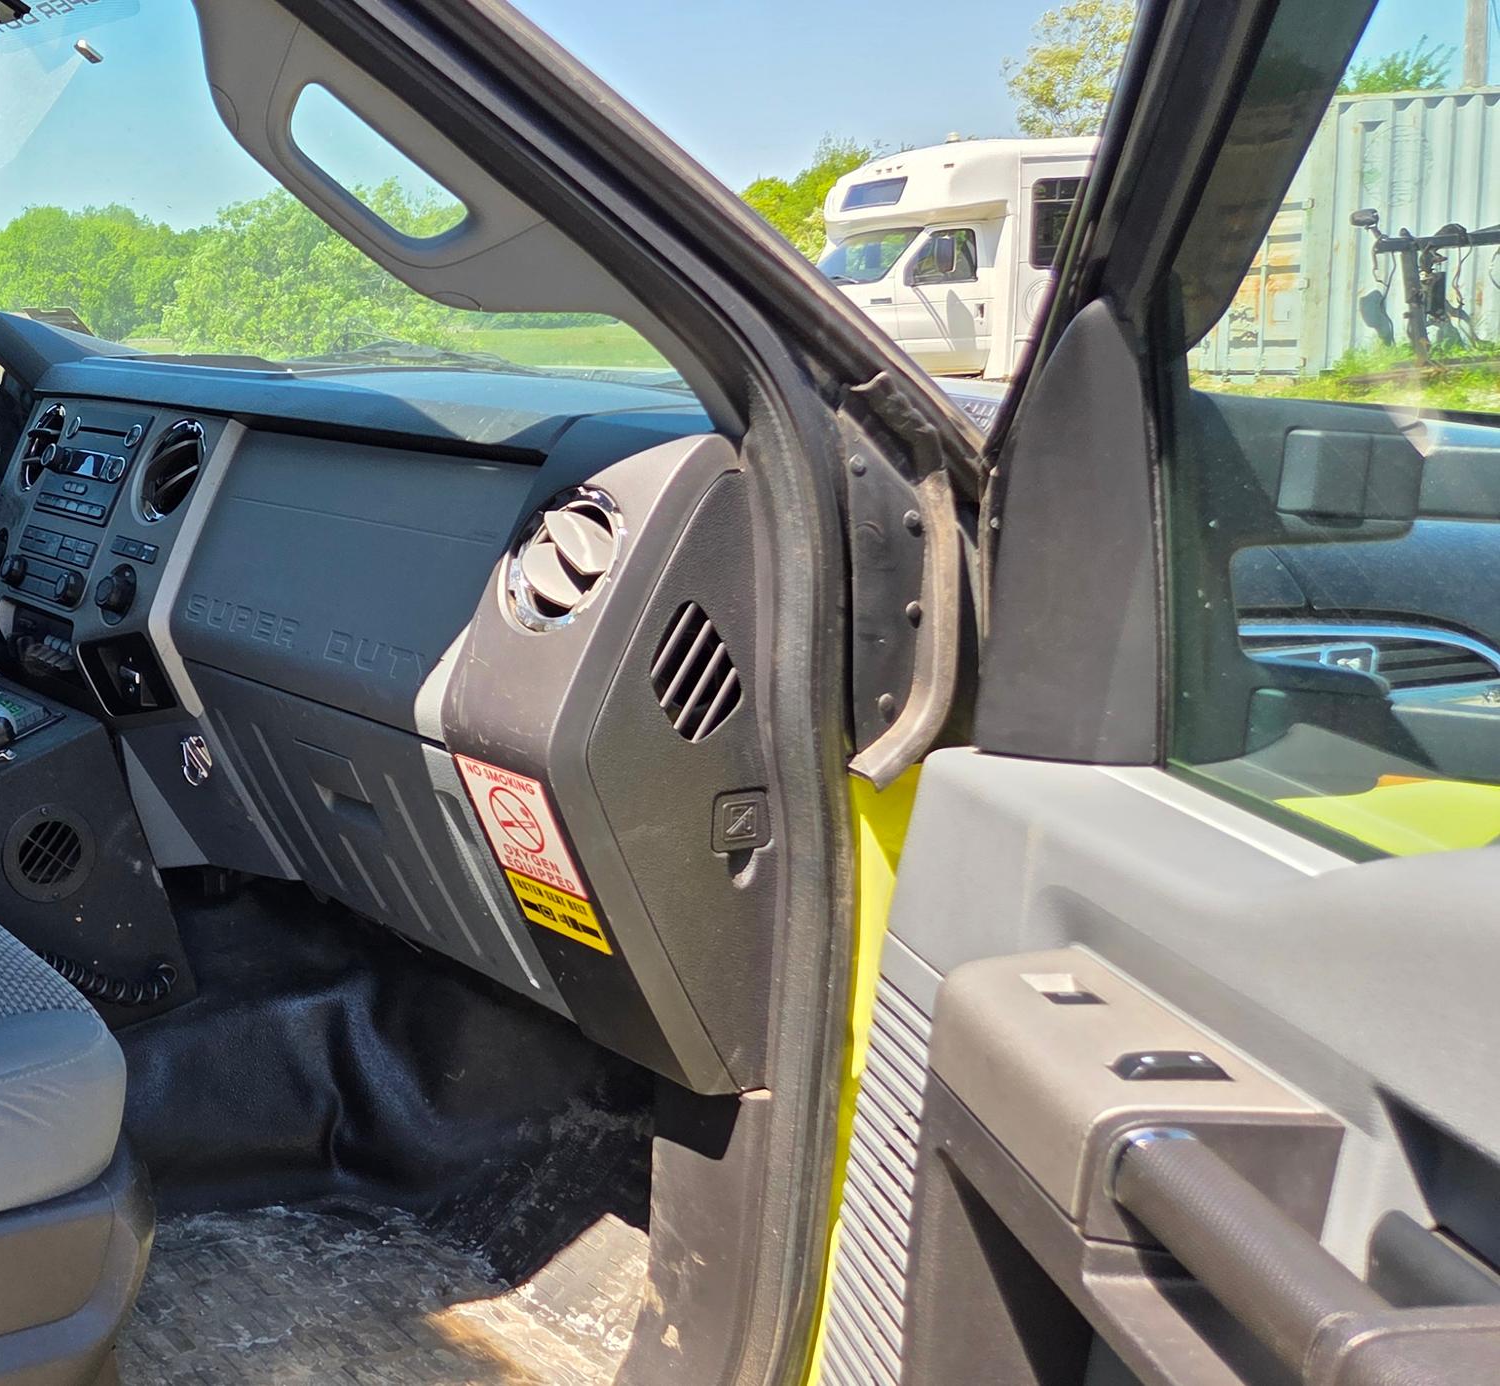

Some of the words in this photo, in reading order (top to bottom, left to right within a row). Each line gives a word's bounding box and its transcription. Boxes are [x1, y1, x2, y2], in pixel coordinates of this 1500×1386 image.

[185, 594, 300, 649] SUPER
[322, 630, 426, 686] DUTY
[465, 762, 482, 776] NO
[485, 767, 535, 795] SMOKING
[503, 843, 560, 874] OXYGEN
[506, 856, 576, 892] EQUIPPED
